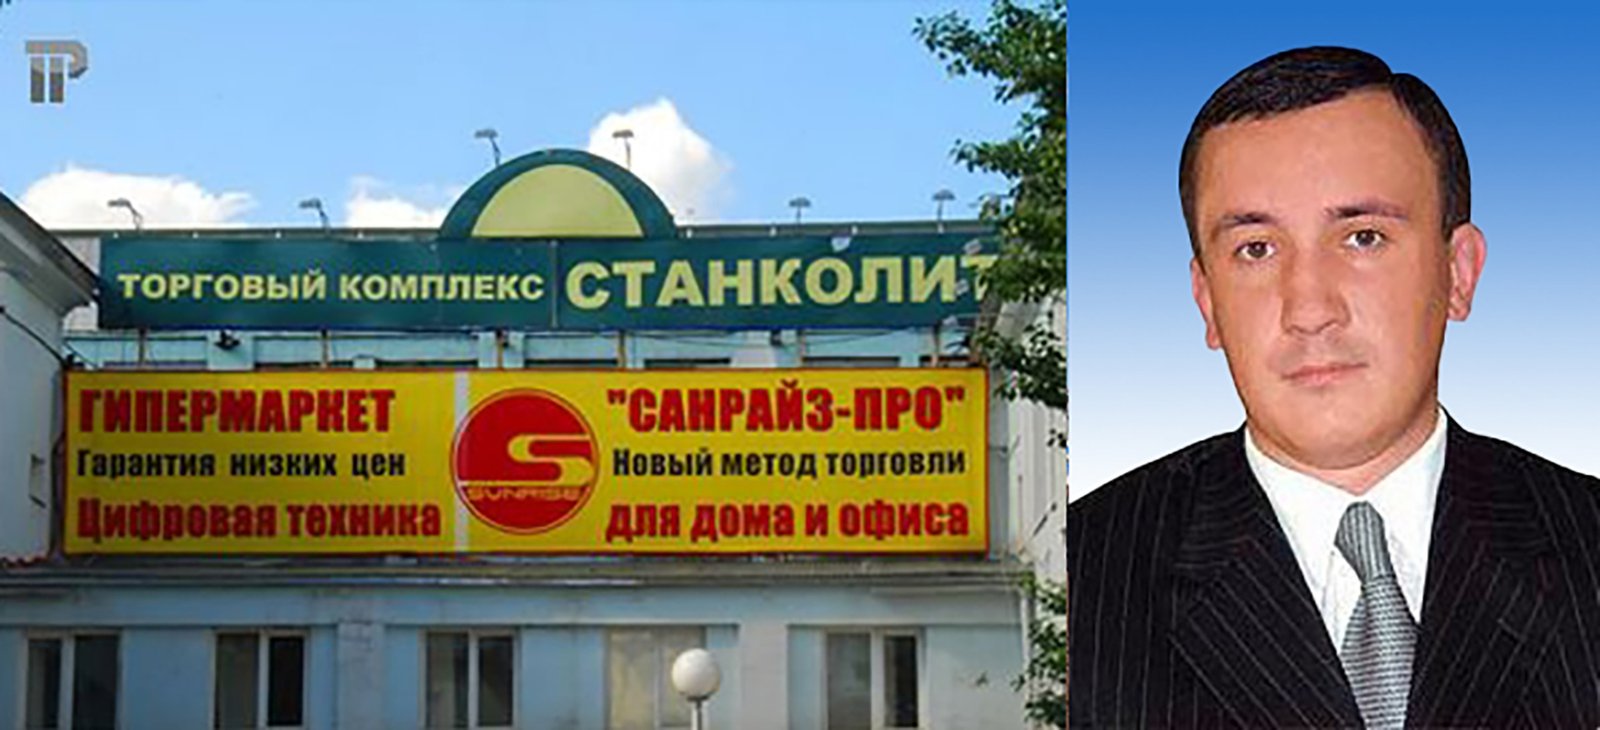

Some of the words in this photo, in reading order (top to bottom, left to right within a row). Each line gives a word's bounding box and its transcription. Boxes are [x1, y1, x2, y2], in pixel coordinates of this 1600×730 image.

[117, 269, 328, 301] ТОРГОВЫЙ
[339, 274, 545, 301] КОМПЛЕКС
[78, 389, 396, 433] ГИПЕРМАРКЕТ
[606, 380, 966, 432] "САНРАЙЗ-ПРО"
[77, 450, 215, 480] Гарантия
[230, 452, 338, 476] низких
[351, 452, 406, 480] цен
[612, 447, 712, 476] Новый
[720, 454, 818, 478] метод
[826, 450, 966, 478] торговли
[77, 499, 277, 543] Цифровая
[288, 504, 441, 537] техника
[606, 504, 680, 542] для
[691, 504, 796, 542] дома
[806, 507, 828, 537] и
[839, 500, 969, 540] офиса
